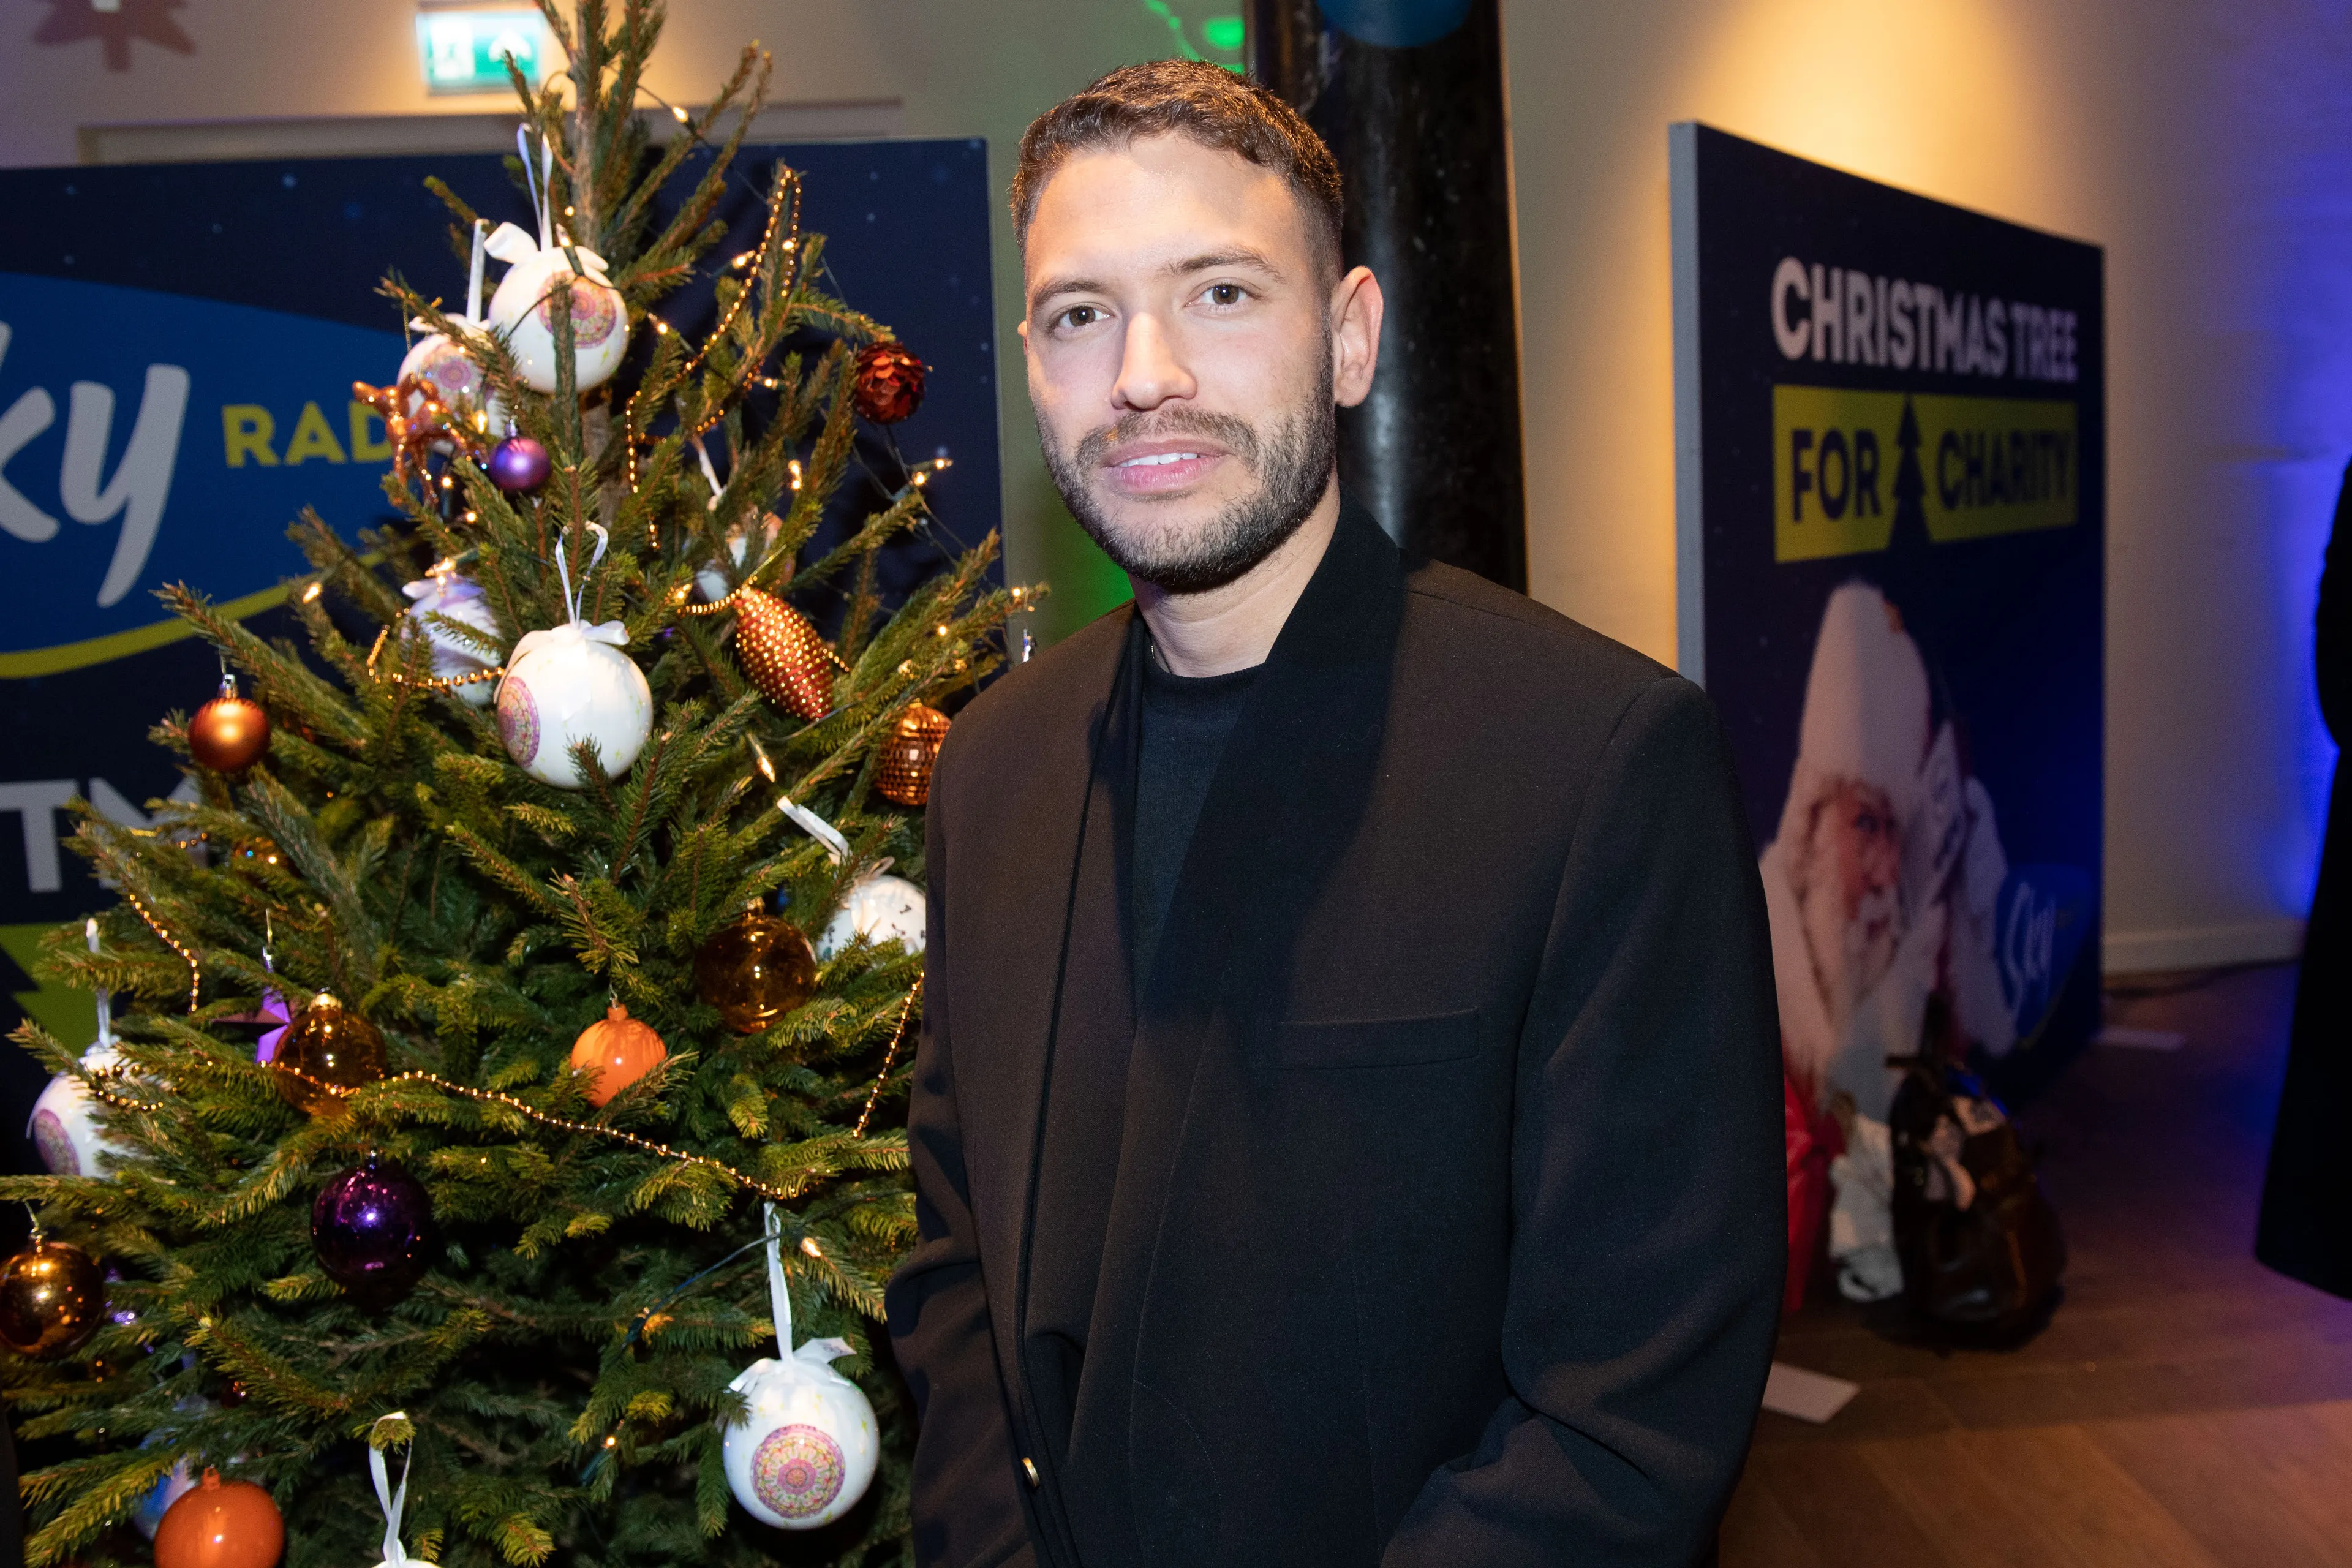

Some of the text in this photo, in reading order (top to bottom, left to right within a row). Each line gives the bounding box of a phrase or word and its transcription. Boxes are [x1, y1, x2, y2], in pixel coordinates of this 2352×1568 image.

[1770, 255, 2079, 384] CHRISTMAS TREE
[1791, 428, 2070, 524] FOR CHARITY
